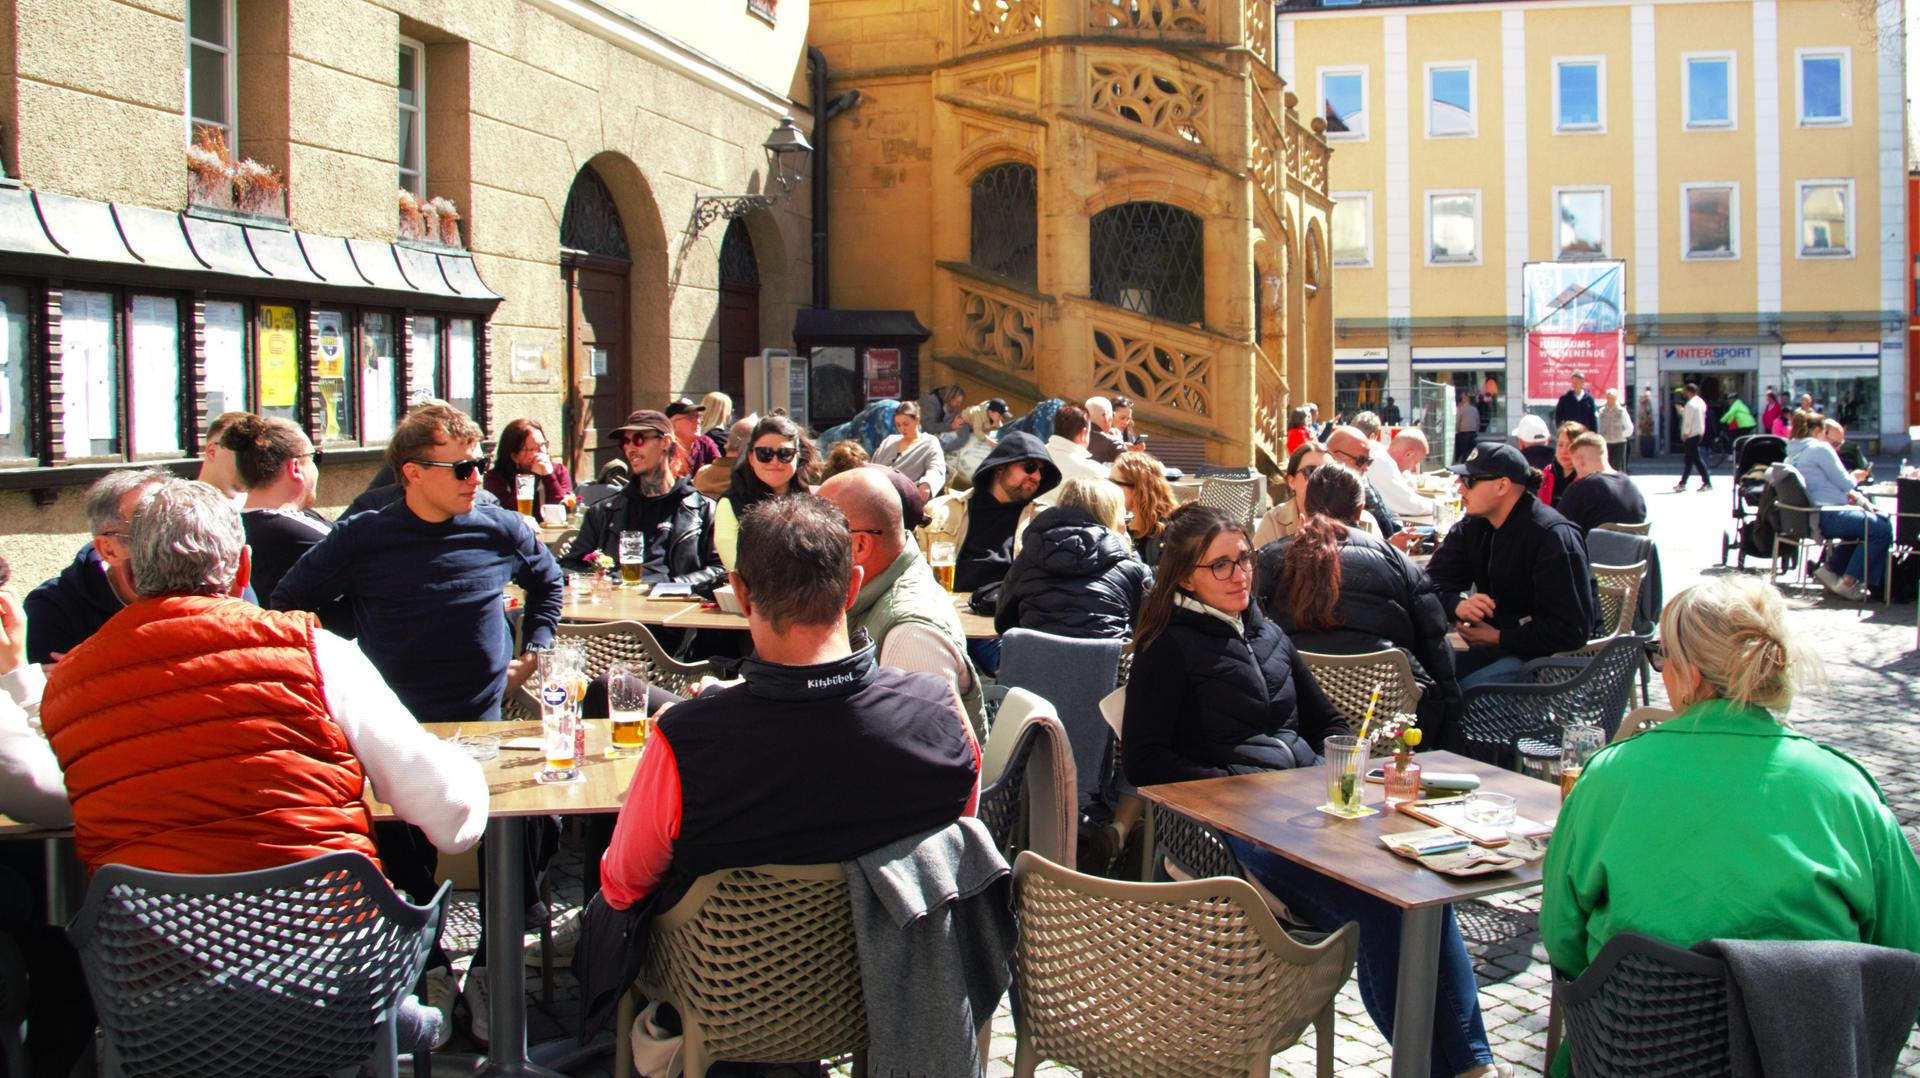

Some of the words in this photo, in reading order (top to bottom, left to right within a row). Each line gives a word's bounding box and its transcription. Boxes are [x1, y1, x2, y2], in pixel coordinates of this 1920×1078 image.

[1676, 347, 1753, 358] INTERSPORT
[1699, 358, 1728, 367] LANGE
[807, 671, 854, 689] Kitzbühel
